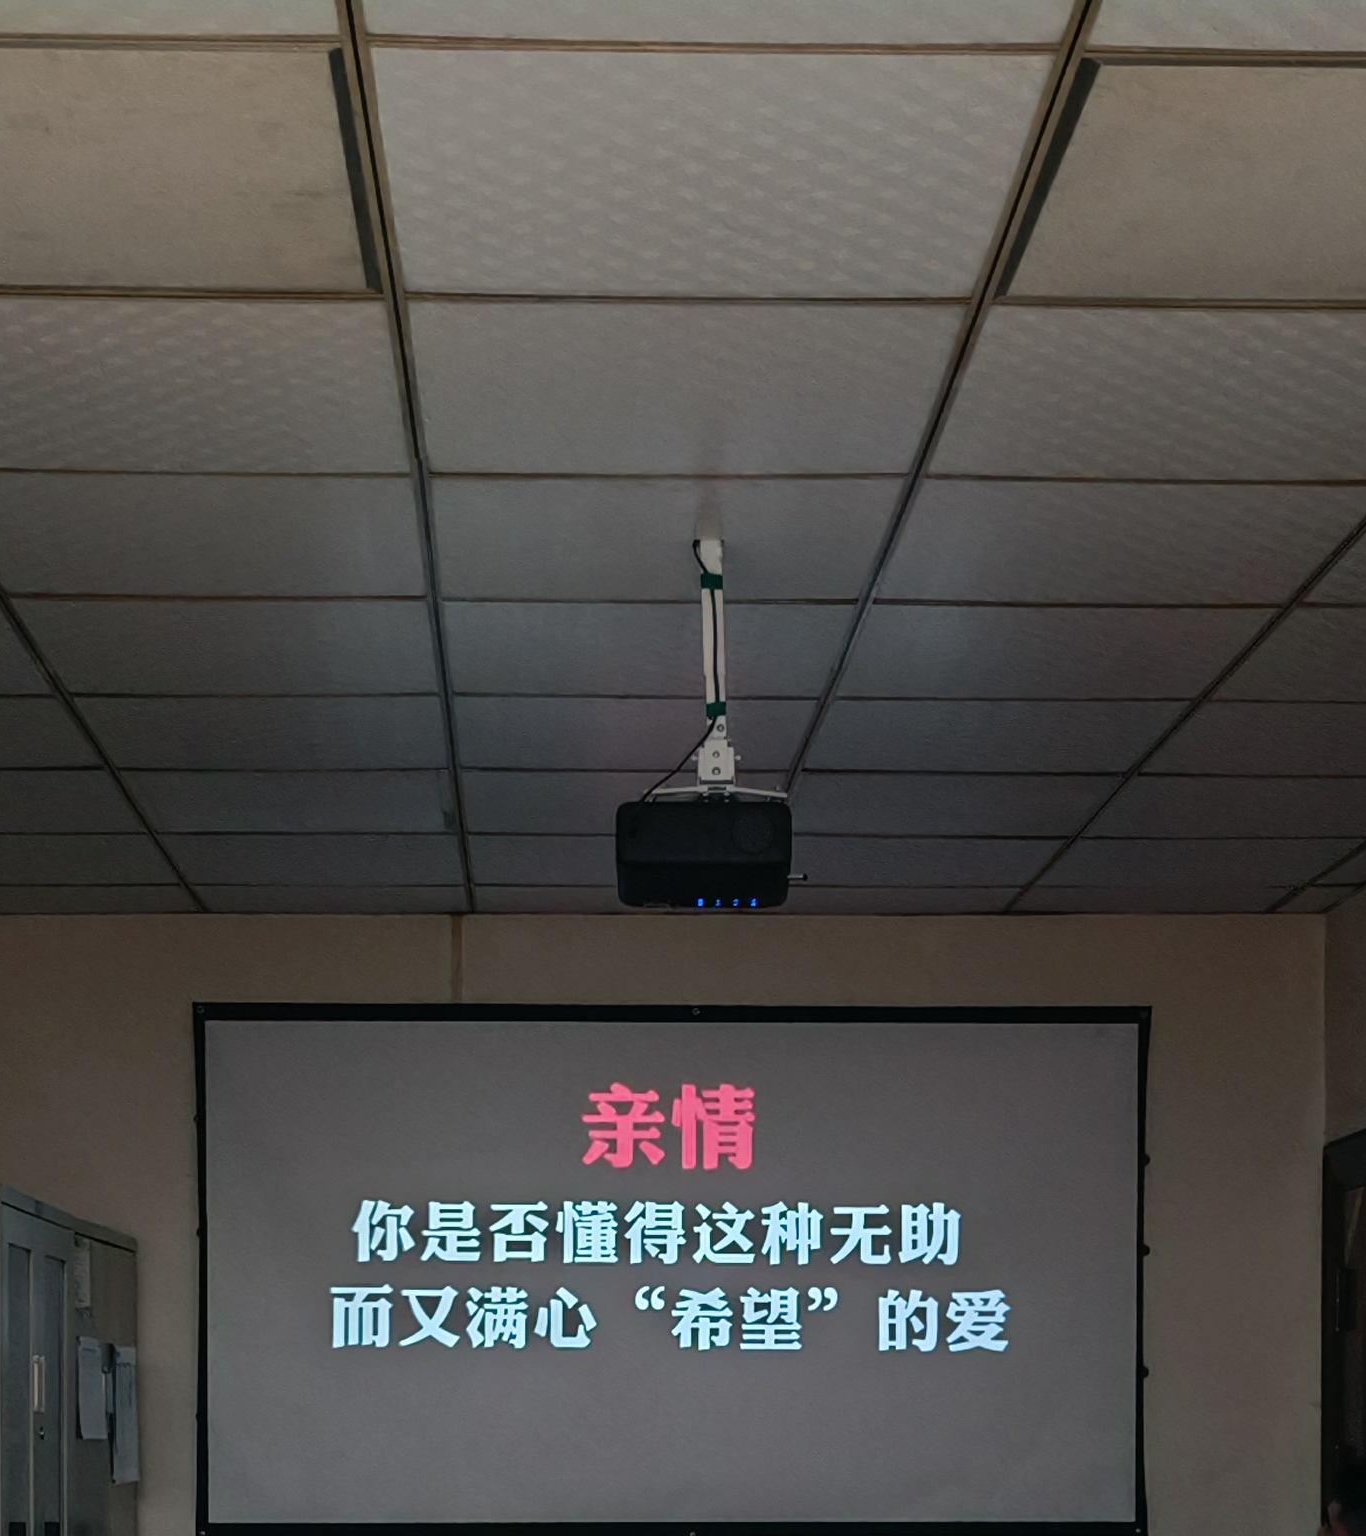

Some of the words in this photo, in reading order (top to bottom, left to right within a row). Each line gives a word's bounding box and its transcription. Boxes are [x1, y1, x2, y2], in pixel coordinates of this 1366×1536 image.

[581, 1081, 756, 1171] 亲情
[350, 1199, 962, 1266] 你是否懂得这种无助
